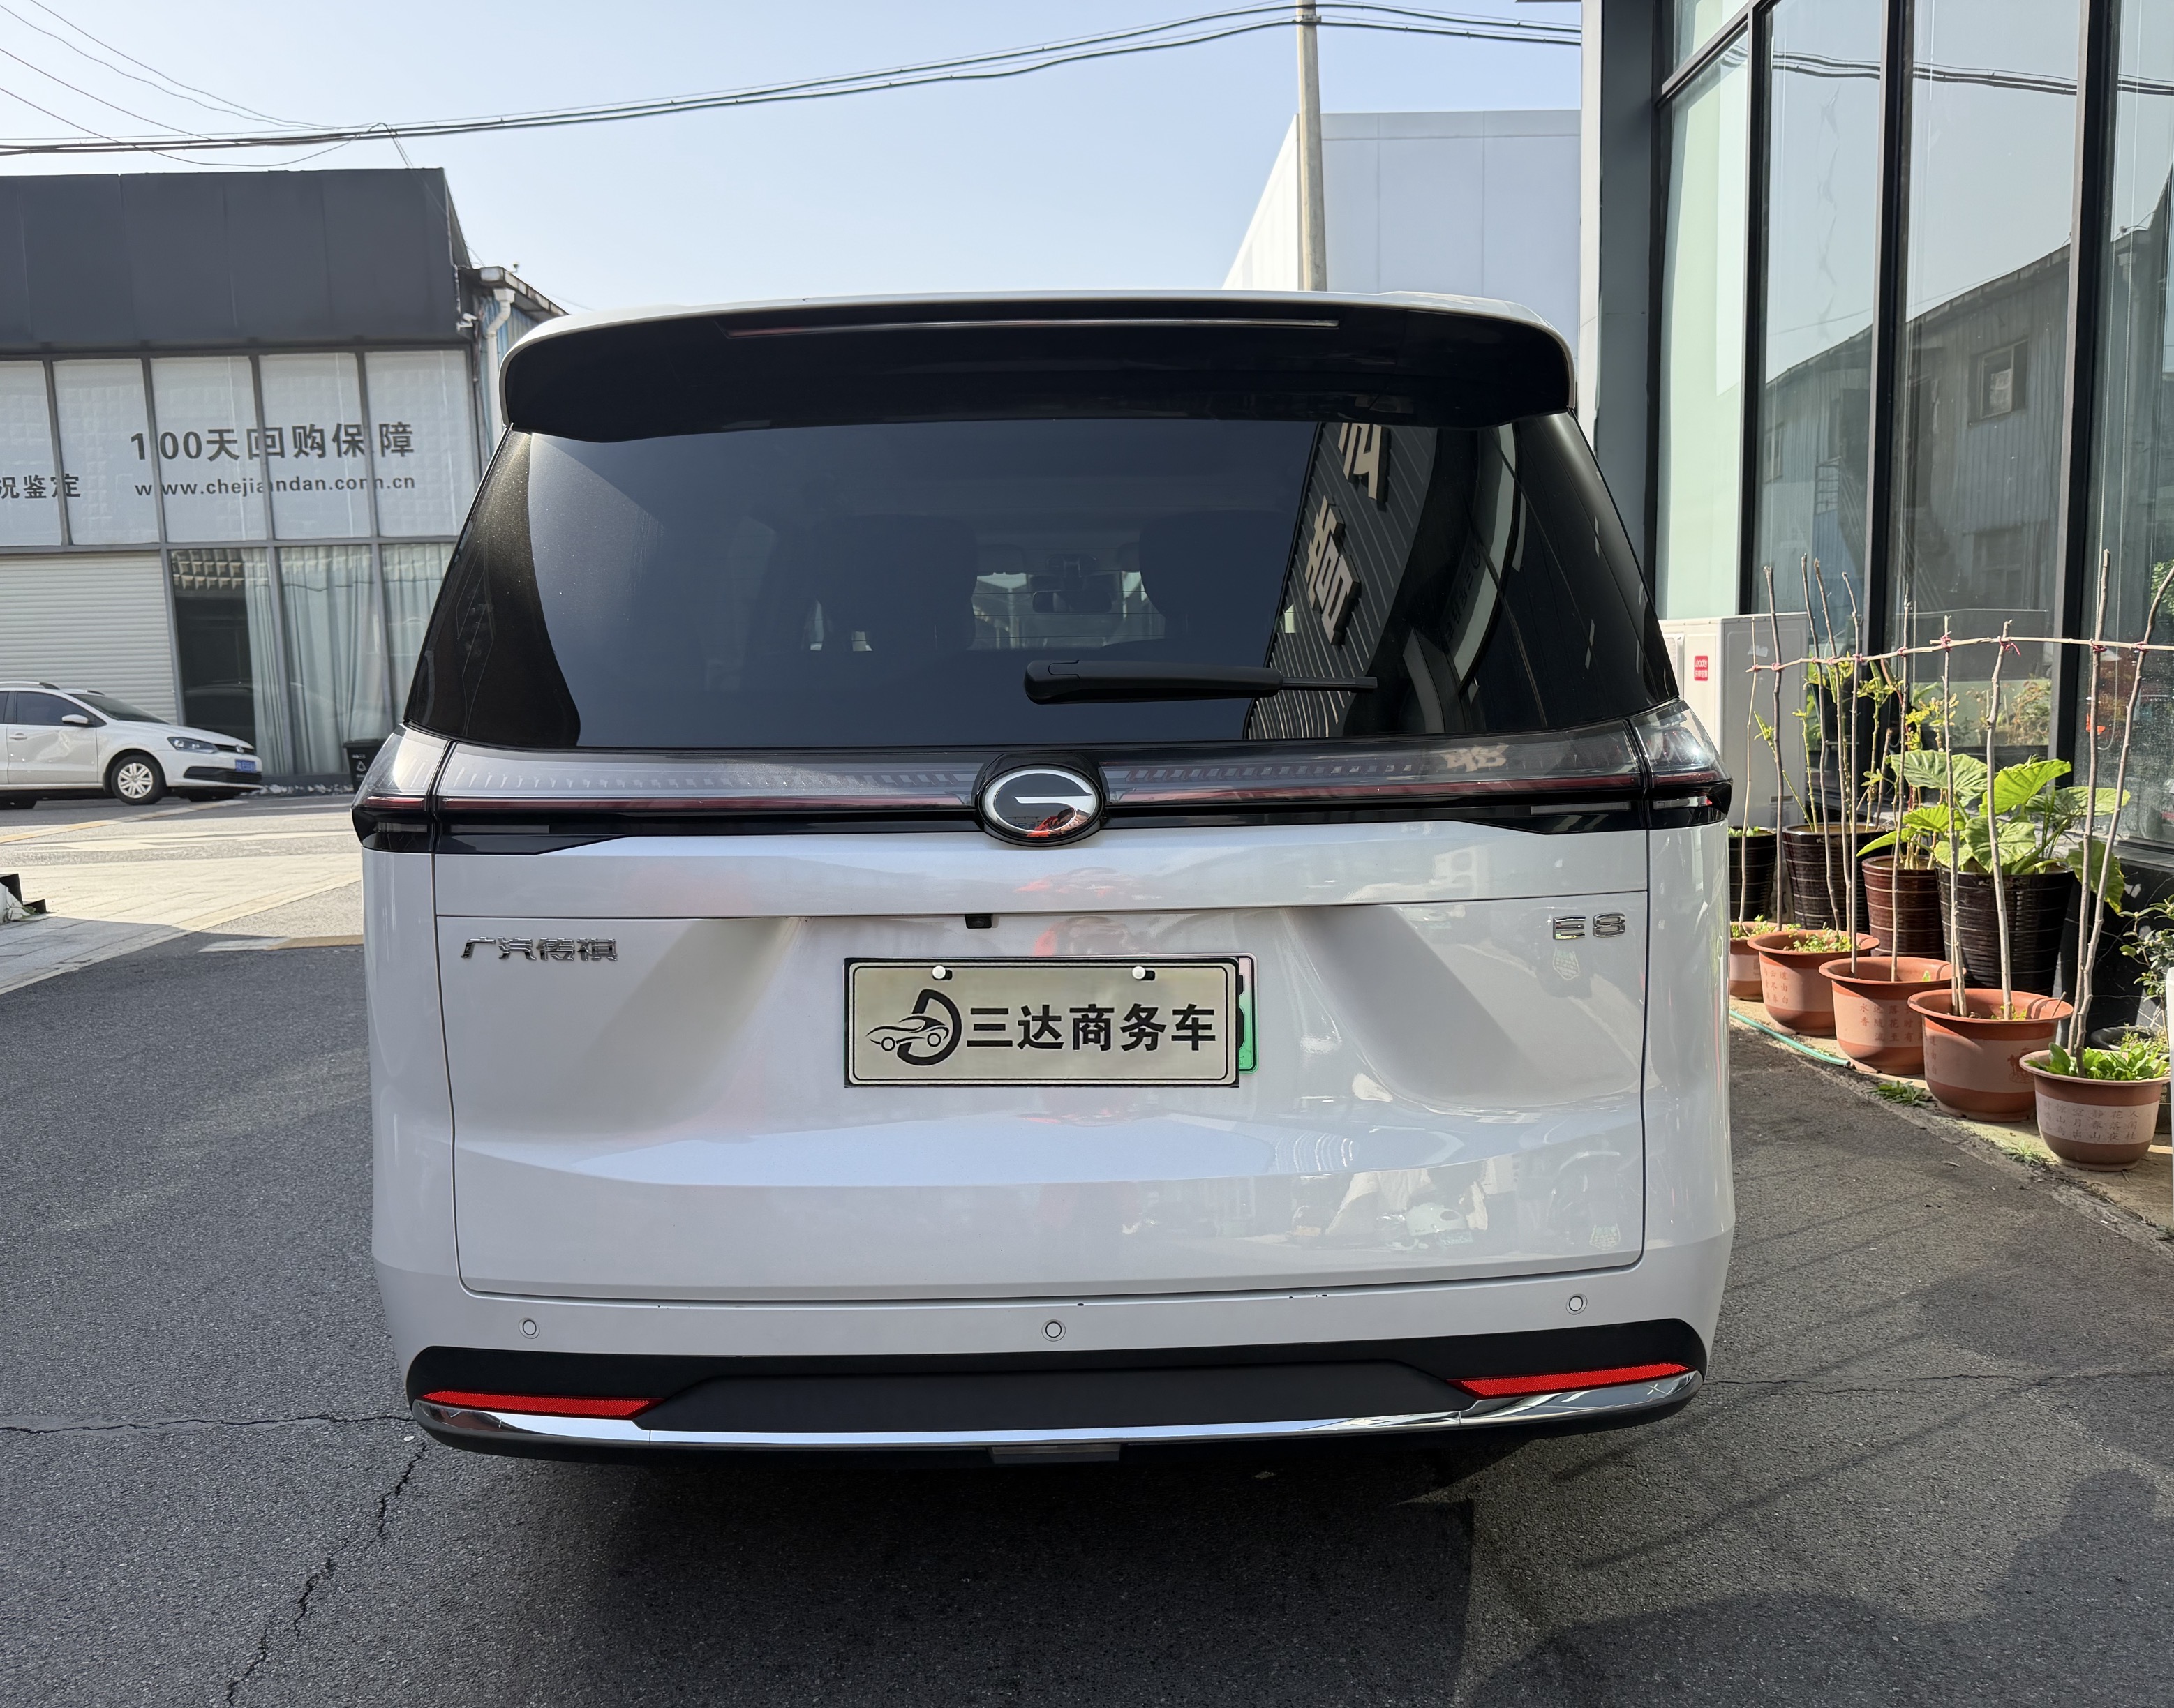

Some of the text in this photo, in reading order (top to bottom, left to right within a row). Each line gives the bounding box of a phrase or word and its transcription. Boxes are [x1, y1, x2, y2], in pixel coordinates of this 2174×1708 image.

[131, 421, 414, 461] 100天回购保障
[1552, 912, 1626, 940] E8
[461, 936, 618, 962] 广汽传祺
[966, 1003, 1216, 1052] 三达商务车
